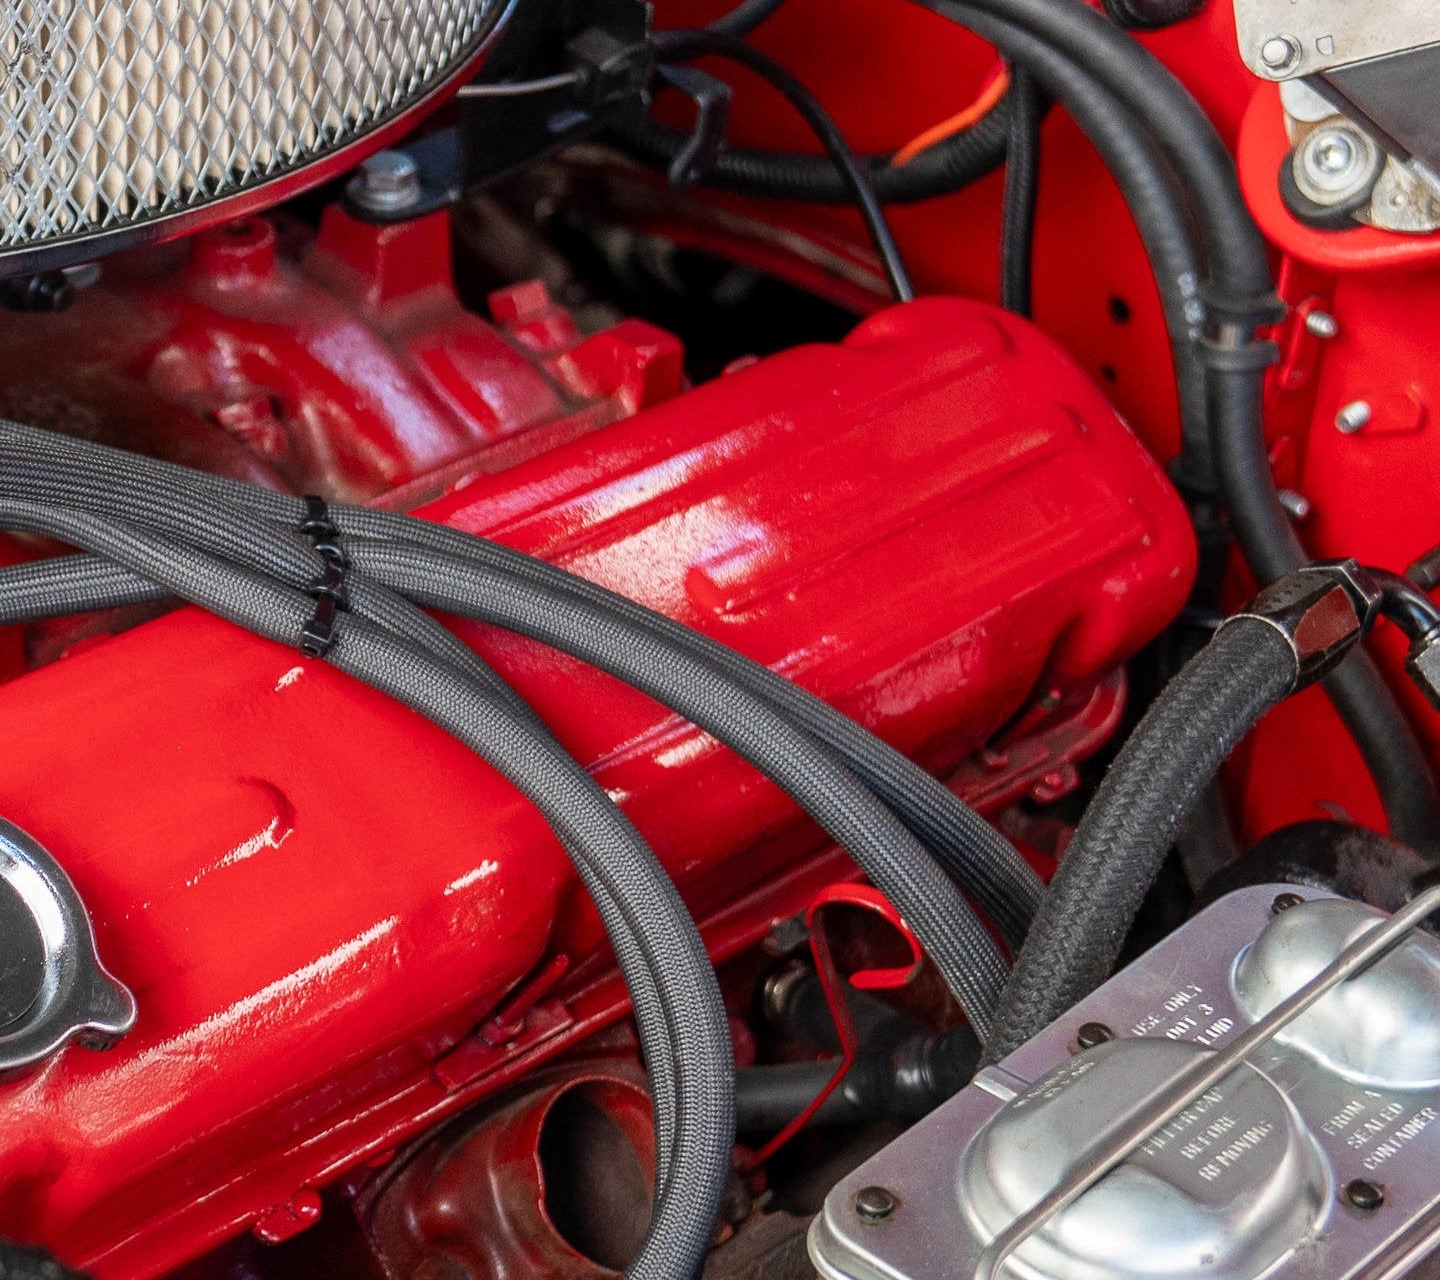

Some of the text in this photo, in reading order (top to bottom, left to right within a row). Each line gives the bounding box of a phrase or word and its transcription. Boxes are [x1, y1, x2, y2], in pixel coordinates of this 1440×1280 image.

[1131, 982, 1204, 1038] USE ONLY
[1165, 1003, 1214, 1041] DOT 3
[1179, 1111, 1238, 1161] BEFORE
[1320, 1099, 1366, 1137] FROM
[1346, 1101, 1405, 1151] SEALED
[1361, 1105, 1440, 1172] CONTAINER
[1197, 1119, 1275, 1183] REMOVING
